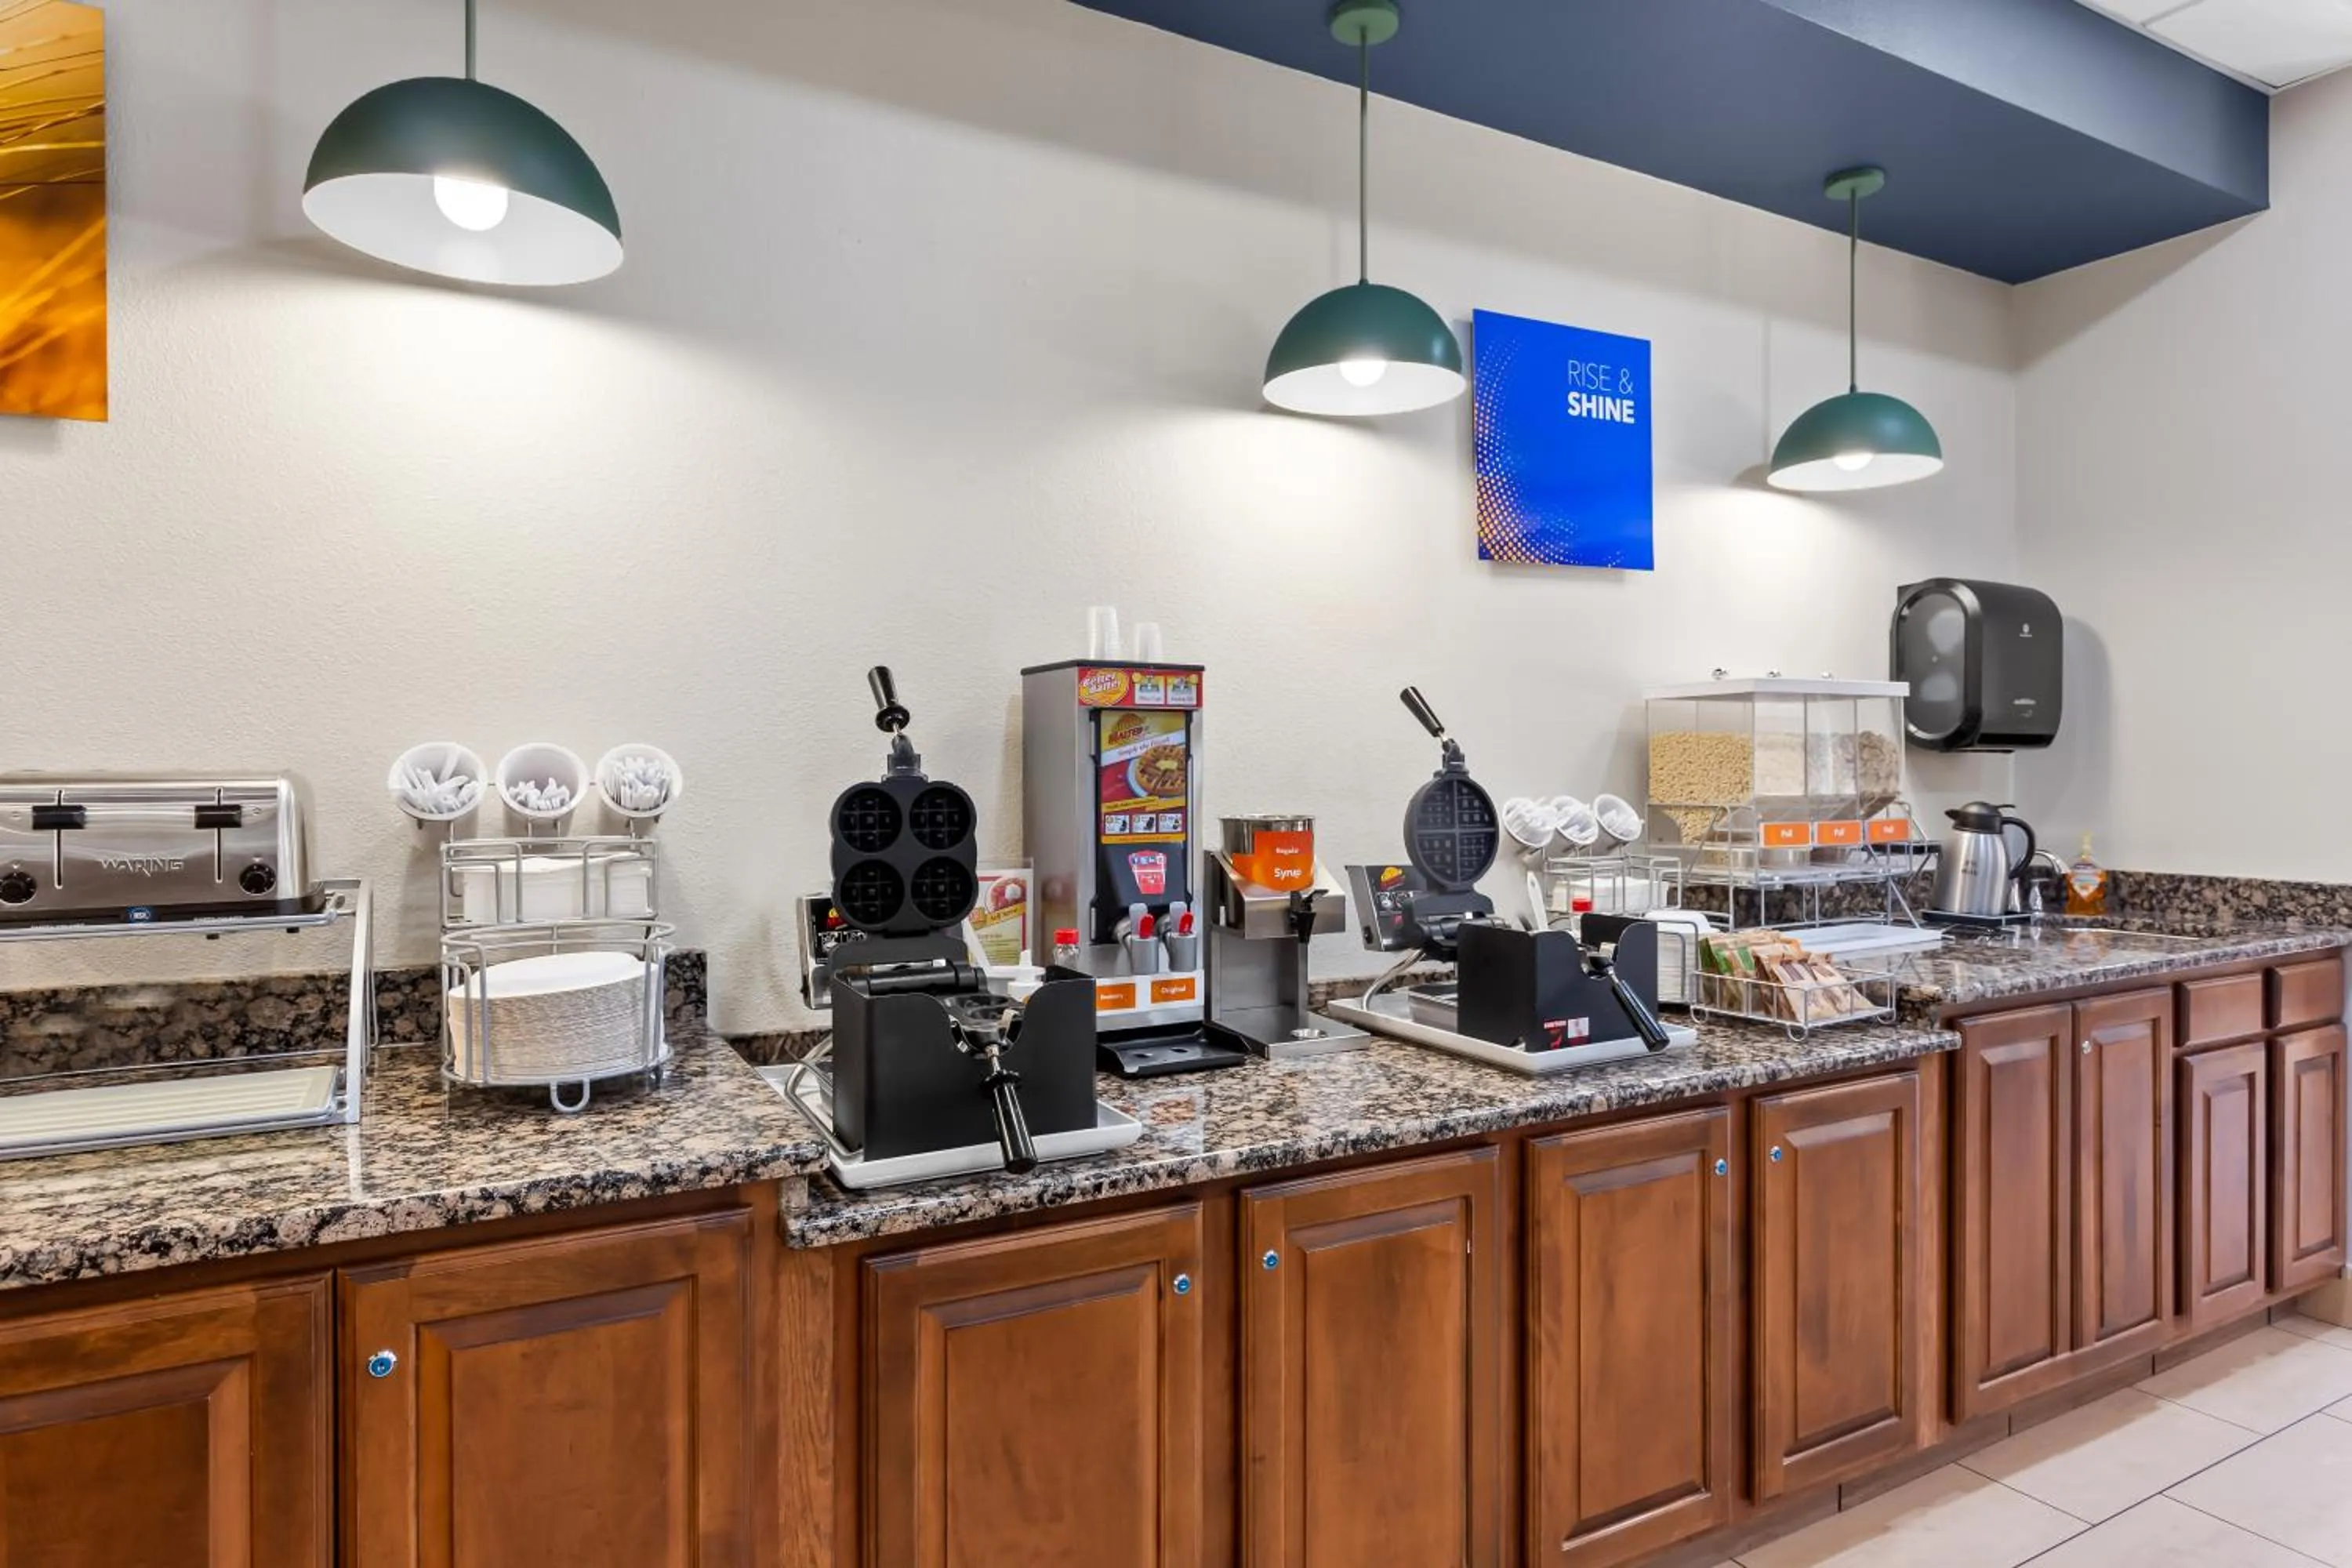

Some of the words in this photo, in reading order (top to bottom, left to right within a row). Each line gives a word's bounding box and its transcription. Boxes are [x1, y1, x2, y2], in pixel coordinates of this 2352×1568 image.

[1568, 360, 1611, 391] RISE
[1619, 368, 1634, 394] &
[1567, 391, 1635, 424] SHINE
[100, 858, 184, 877] WARING
[1273, 866, 1302, 881] Syrup
